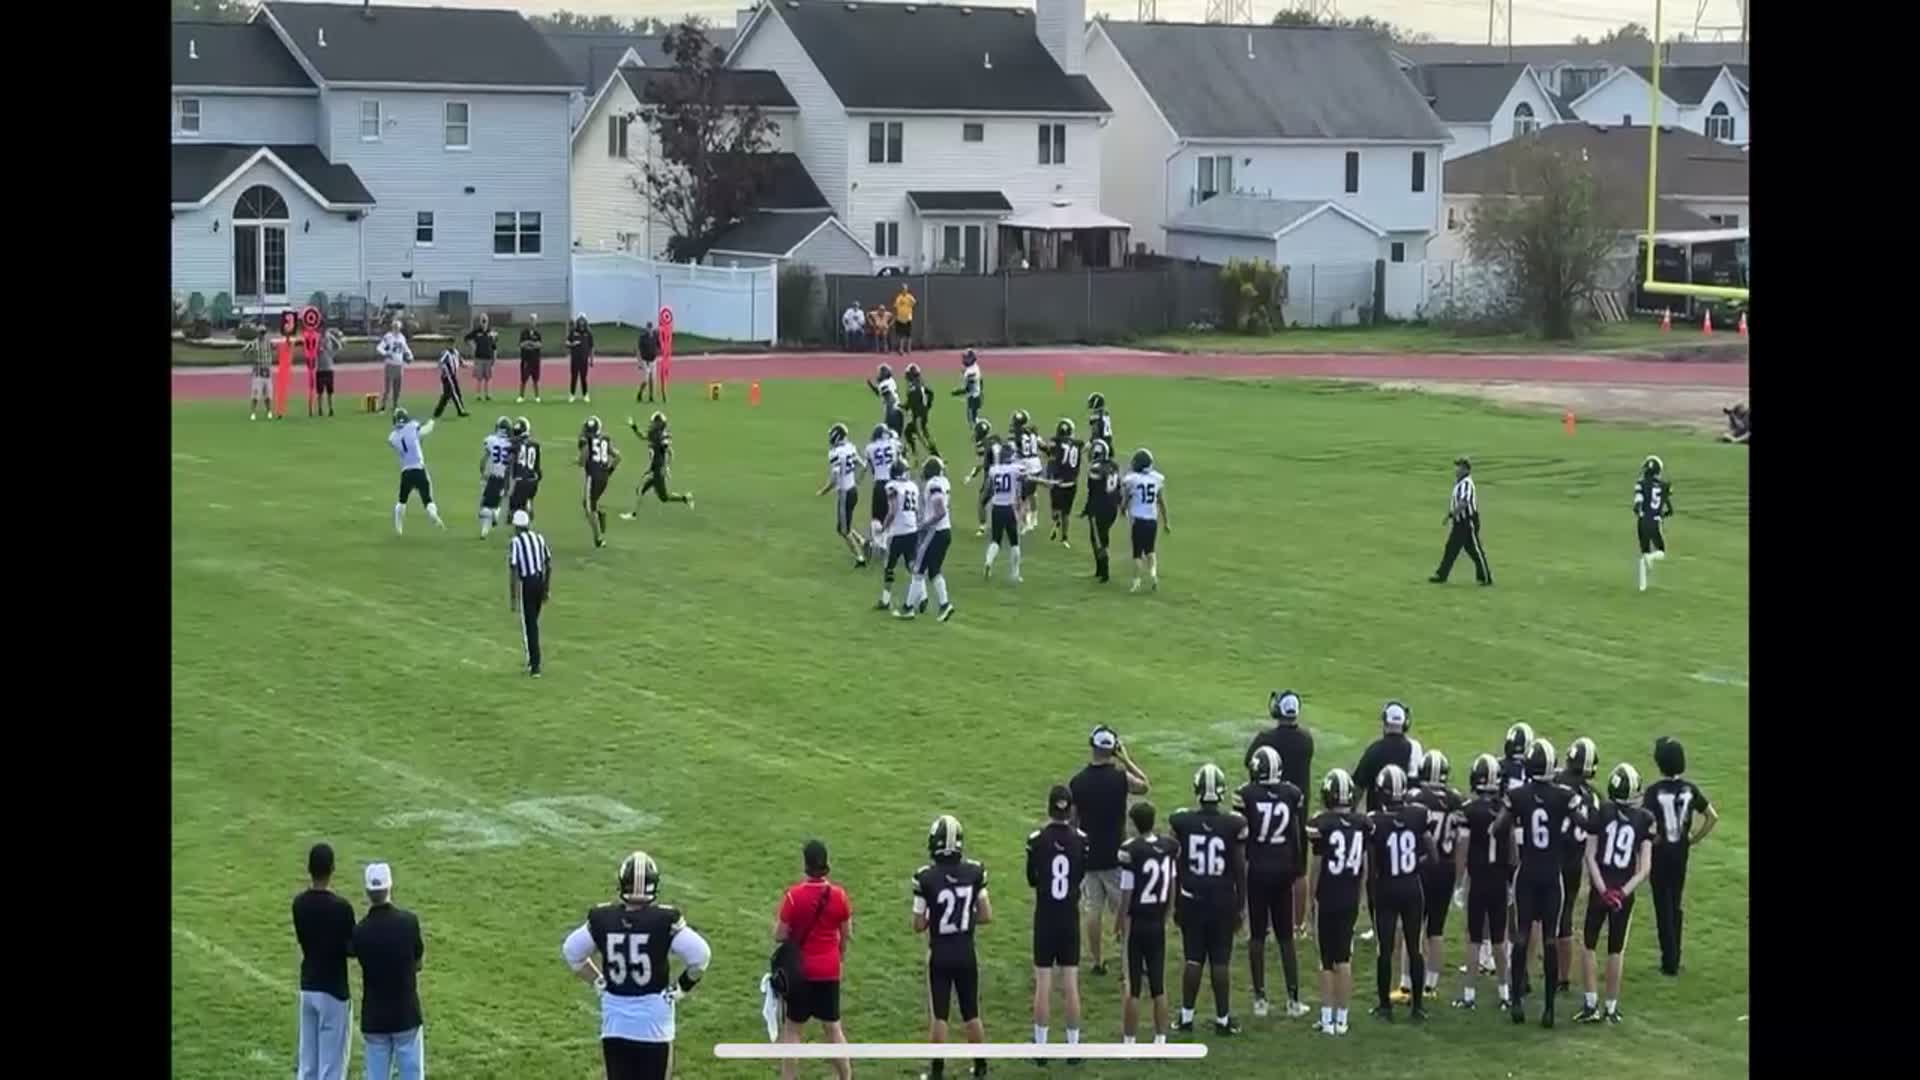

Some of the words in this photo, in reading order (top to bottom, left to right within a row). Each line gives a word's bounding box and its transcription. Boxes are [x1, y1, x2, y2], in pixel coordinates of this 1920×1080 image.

[401, 437, 409, 453] 1
[517, 443, 537, 470] 40
[592, 438, 608, 463] 58
[874, 446, 893, 467] 55
[1061, 443, 1079, 468] 70
[994, 473, 1011, 493] 50
[1136, 483, 1156, 505] 75
[1650, 487, 1662, 510] 5
[1256, 801, 1290, 844] 72
[1531, 808, 1549, 849] 6
[1188, 834, 1226, 876] 56
[1328, 830, 1363, 875] 34
[1386, 830, 1417, 876] 18
[1603, 820, 1635, 868] 19
[1051, 854, 1069, 900] 8
[1140, 855, 1170, 904] 21
[936, 885, 973, 934] 27
[606, 933, 652, 986] 55
